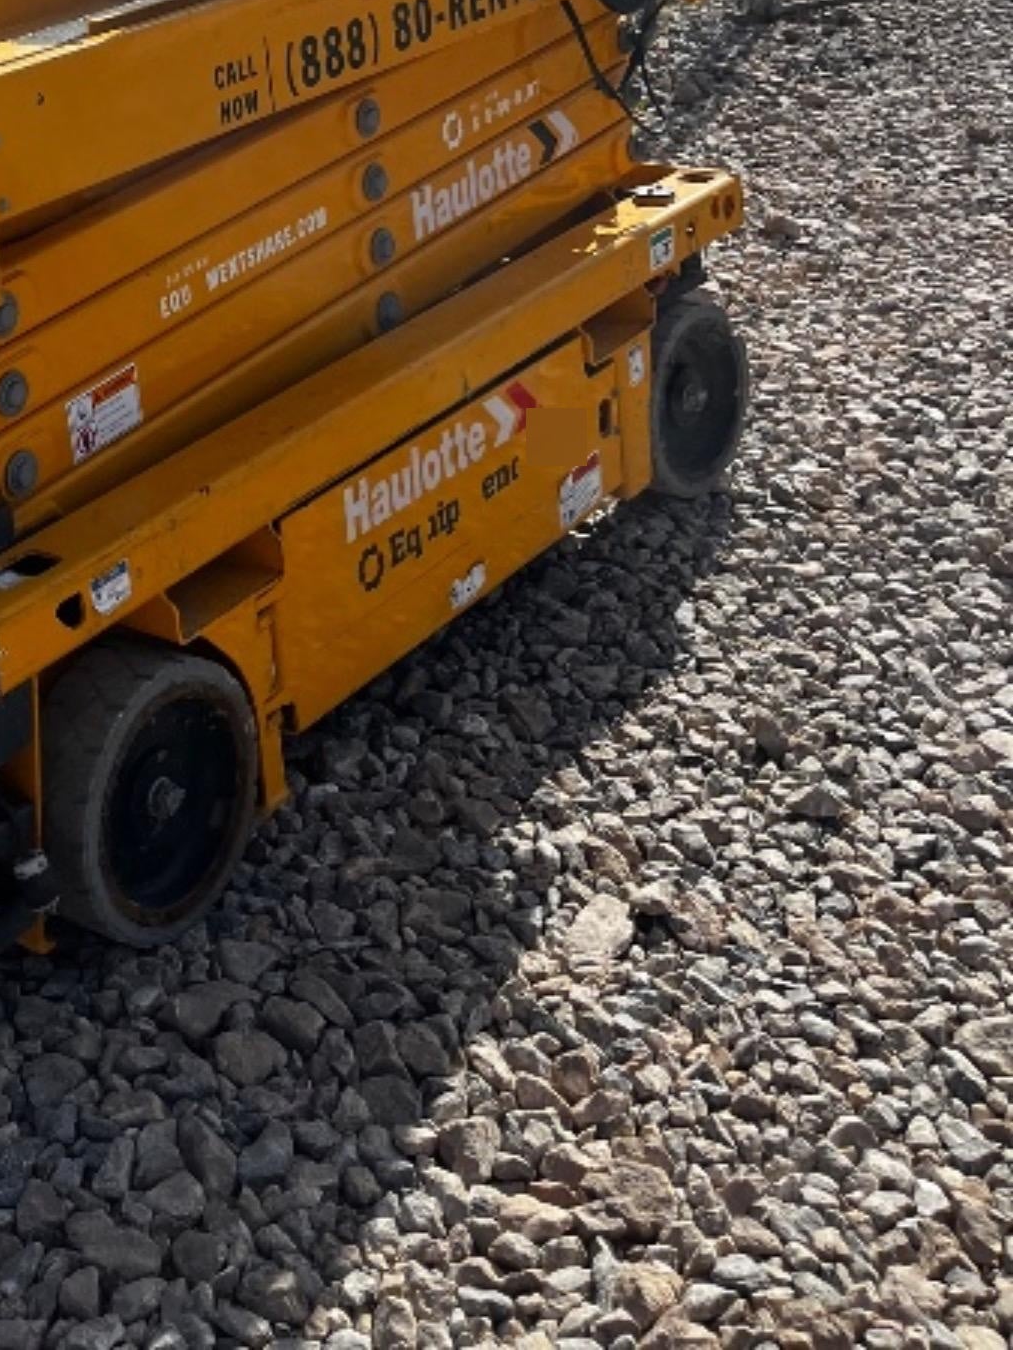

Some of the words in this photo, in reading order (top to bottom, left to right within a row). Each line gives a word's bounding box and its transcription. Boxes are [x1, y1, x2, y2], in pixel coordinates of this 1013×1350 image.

[213, 54, 259, 91] CALL
[286, 11, 379, 97] (888)
[409, 138, 532, 242] Haulotte
[343, 421, 487, 544] Haulotte
